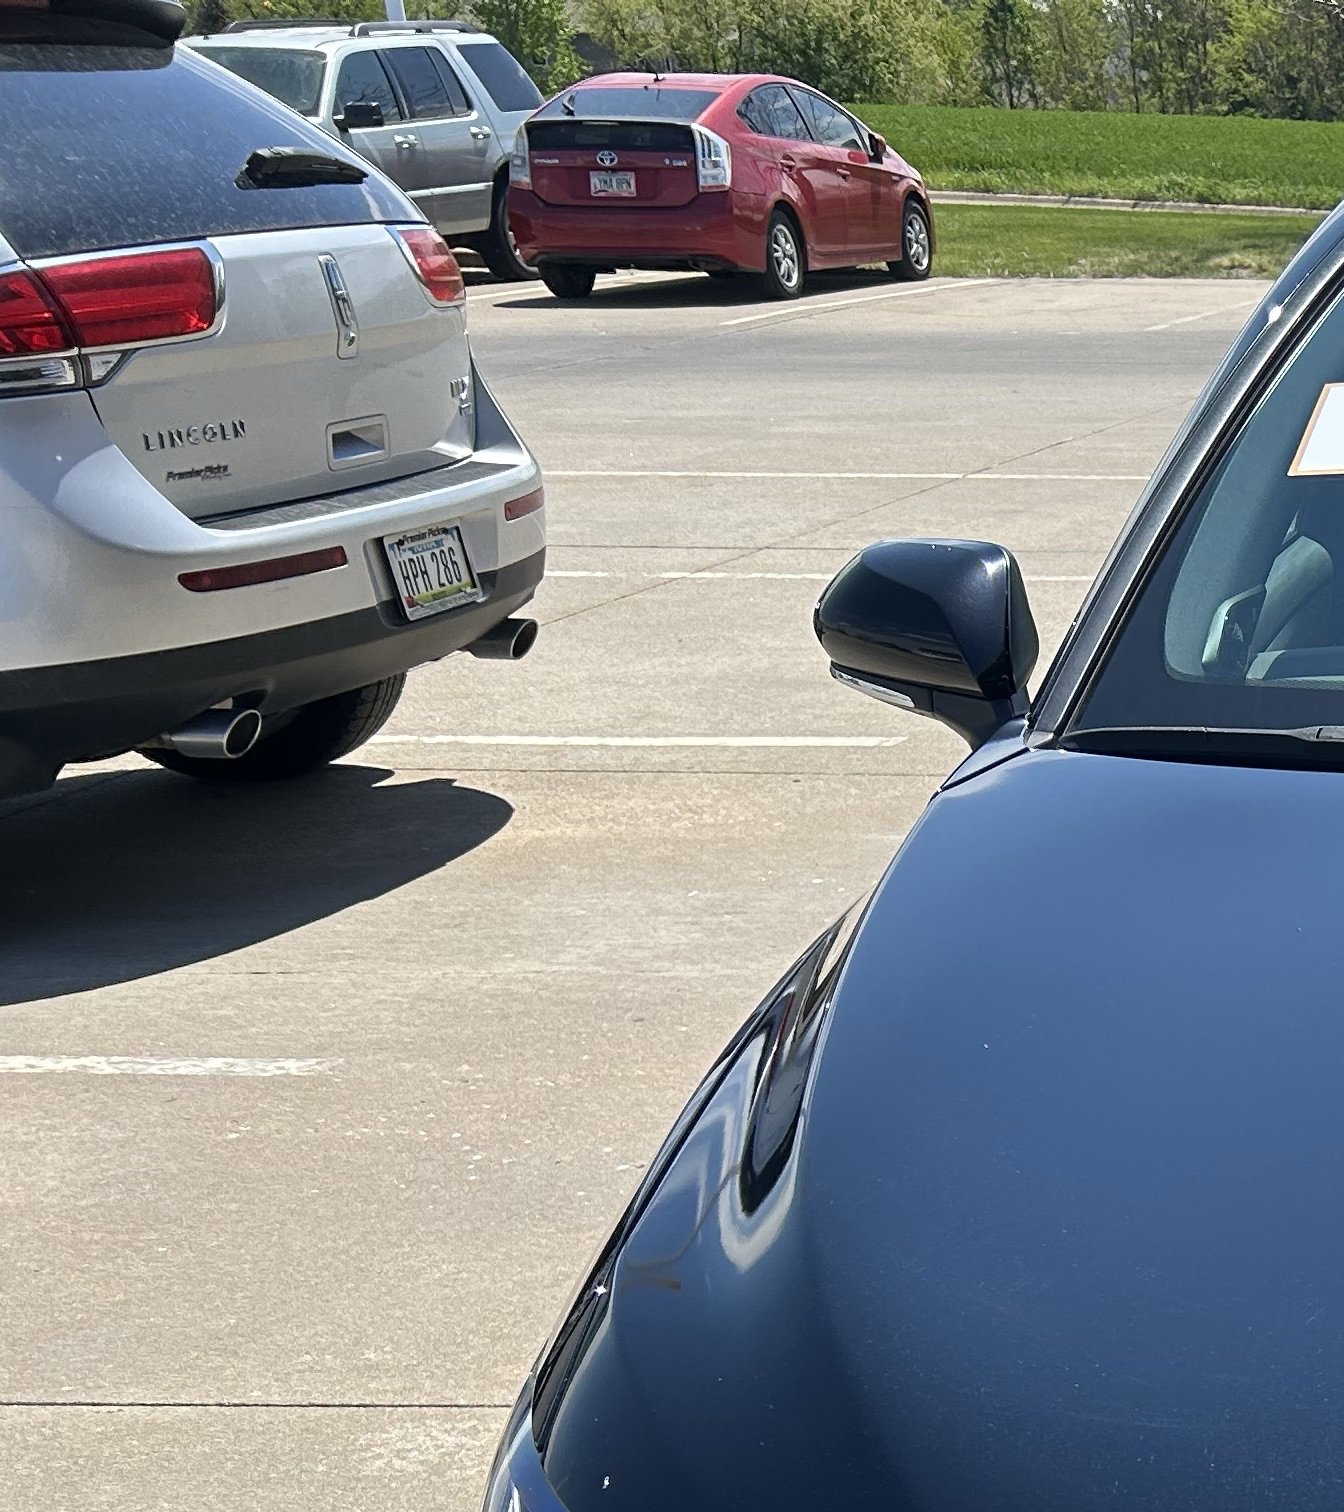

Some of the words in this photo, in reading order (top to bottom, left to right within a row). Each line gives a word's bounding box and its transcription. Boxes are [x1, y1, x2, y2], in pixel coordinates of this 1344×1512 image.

[142, 420, 246, 451] LINCOLN
[398, 554, 434, 597] HPH
[430, 547, 462, 589] 286
